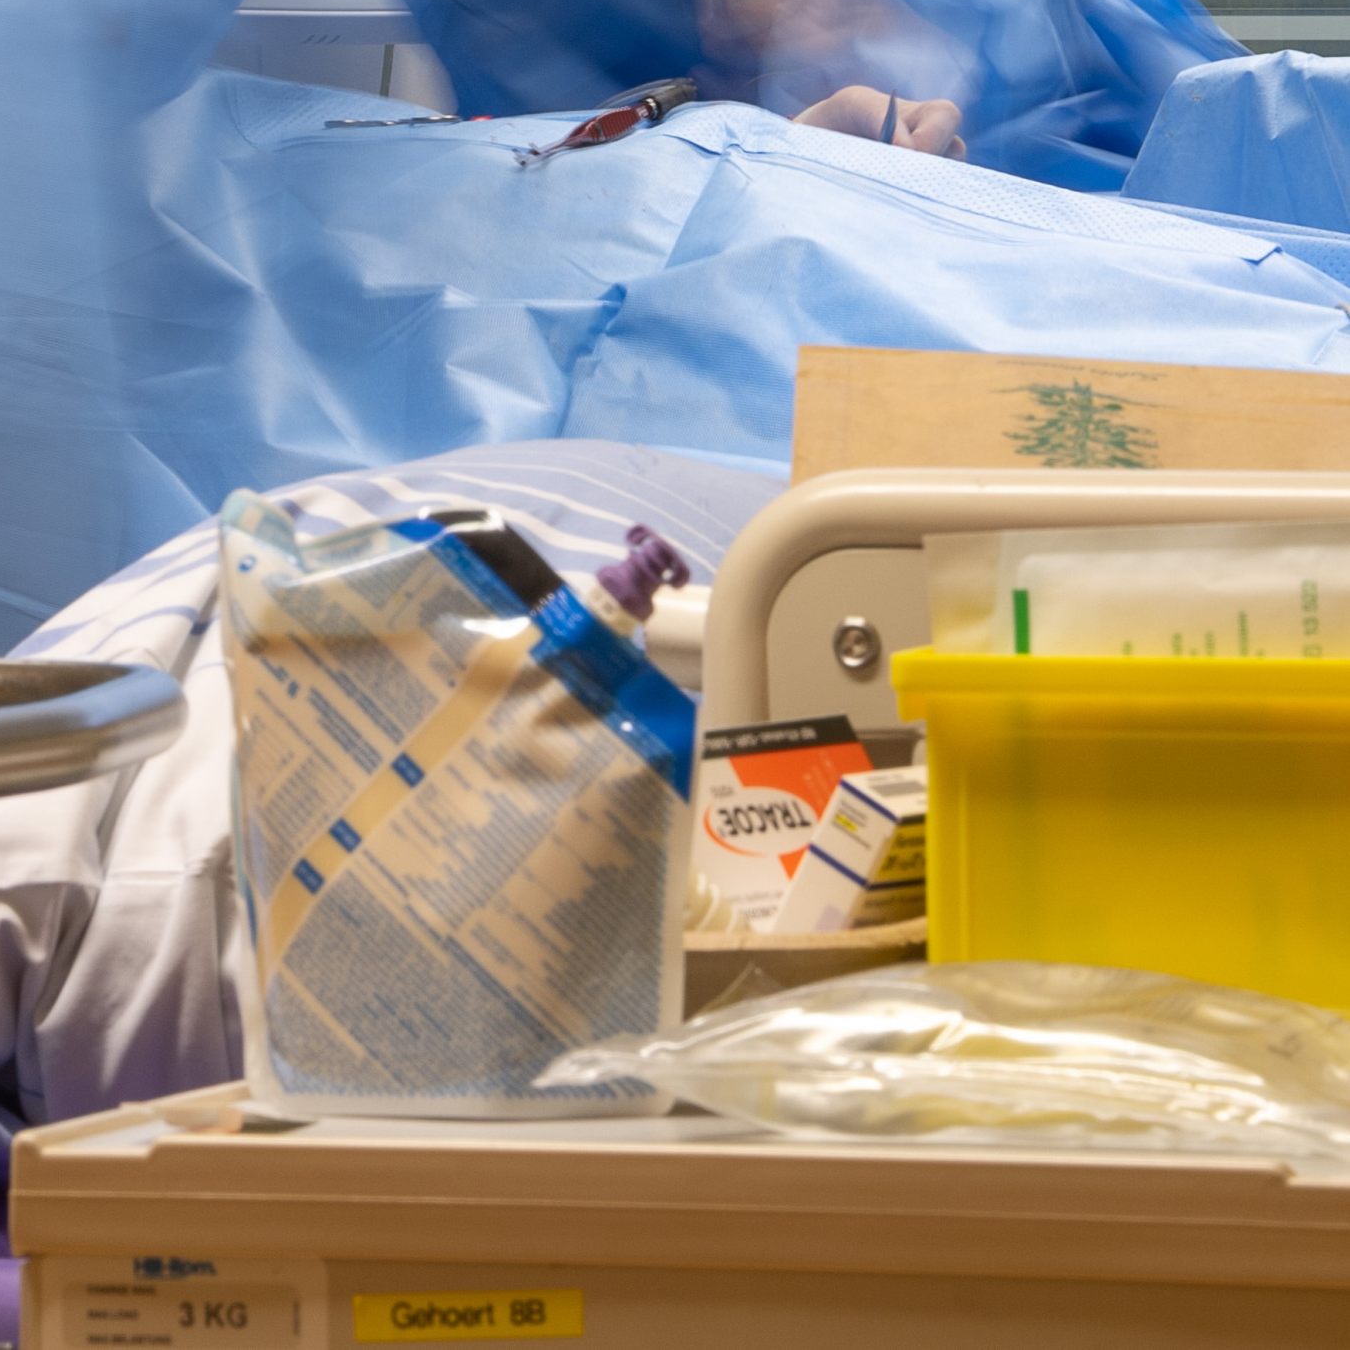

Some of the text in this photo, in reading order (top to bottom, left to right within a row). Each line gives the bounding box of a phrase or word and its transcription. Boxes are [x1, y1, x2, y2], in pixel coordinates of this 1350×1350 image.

[718, 799, 811, 836] TRACOE
[179, 1301, 248, 1329] 3 KG
[390, 1299, 546, 1330] Gehoert 8B
